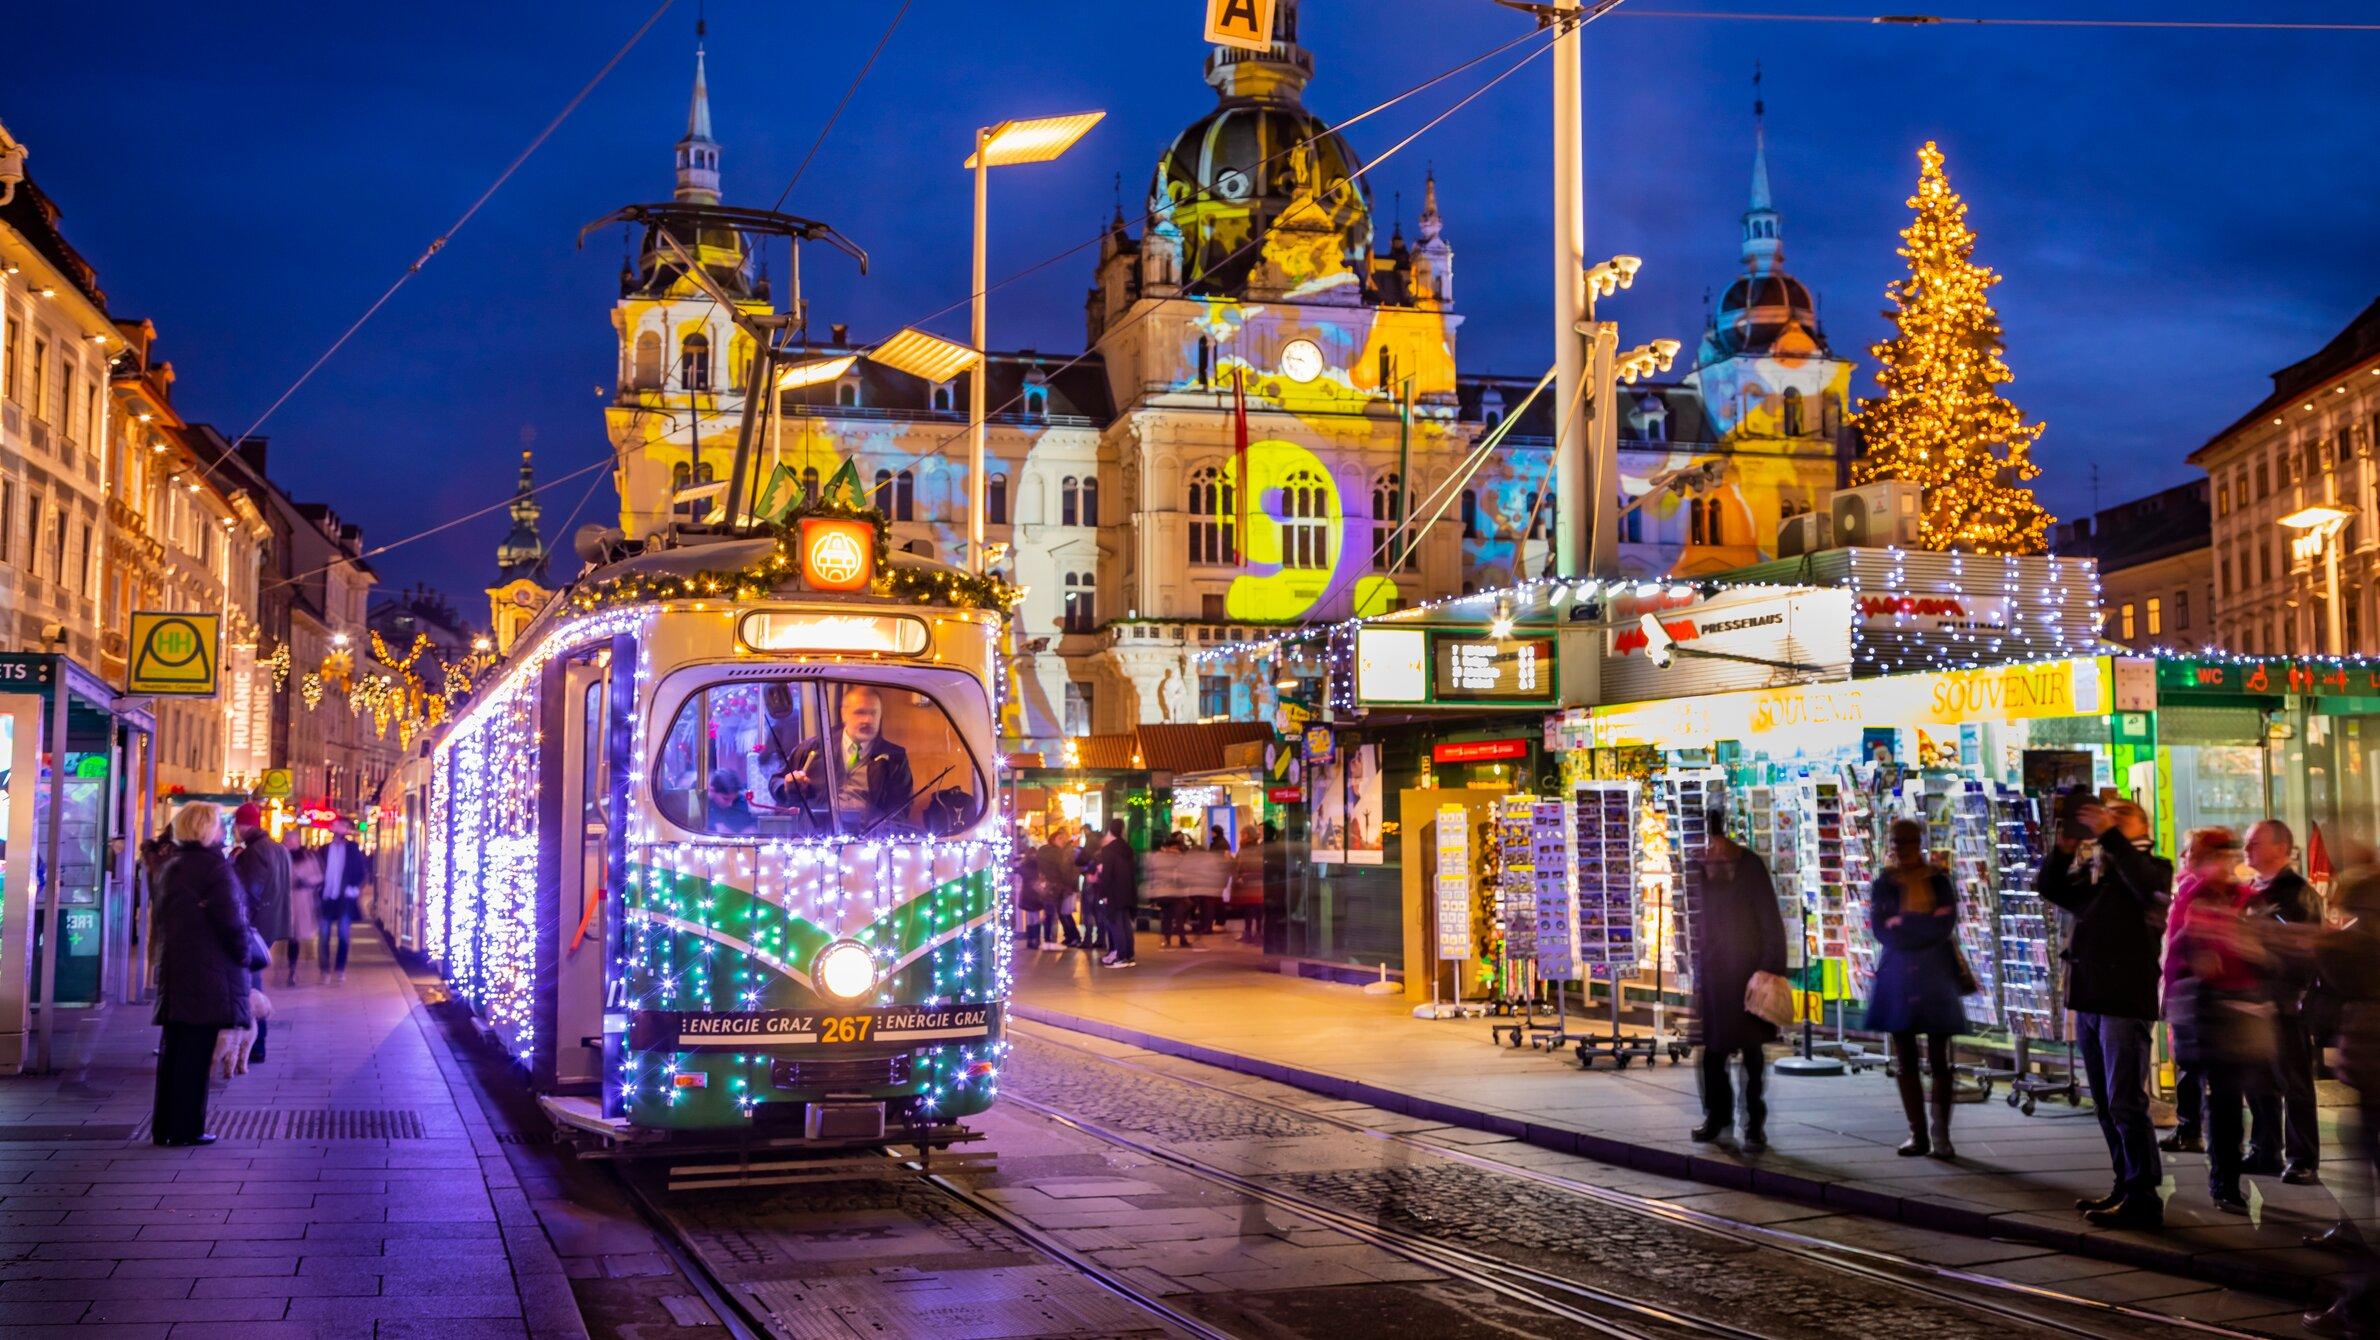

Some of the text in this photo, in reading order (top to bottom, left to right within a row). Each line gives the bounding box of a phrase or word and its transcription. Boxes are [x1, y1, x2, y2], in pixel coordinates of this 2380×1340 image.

[1221, 0, 1258, 33] A
[1701, 613, 1783, 635] PRESSEHAUS
[2197, 667, 2224, 685] WC
[1932, 672, 2065, 715] SOUVENIR
[232, 671, 251, 750] HUMANIC
[251, 684, 269, 757] HUMANIC
[690, 1010, 986, 1043] ENERGIE GRAZ 267 ENERGIE GRAZ
